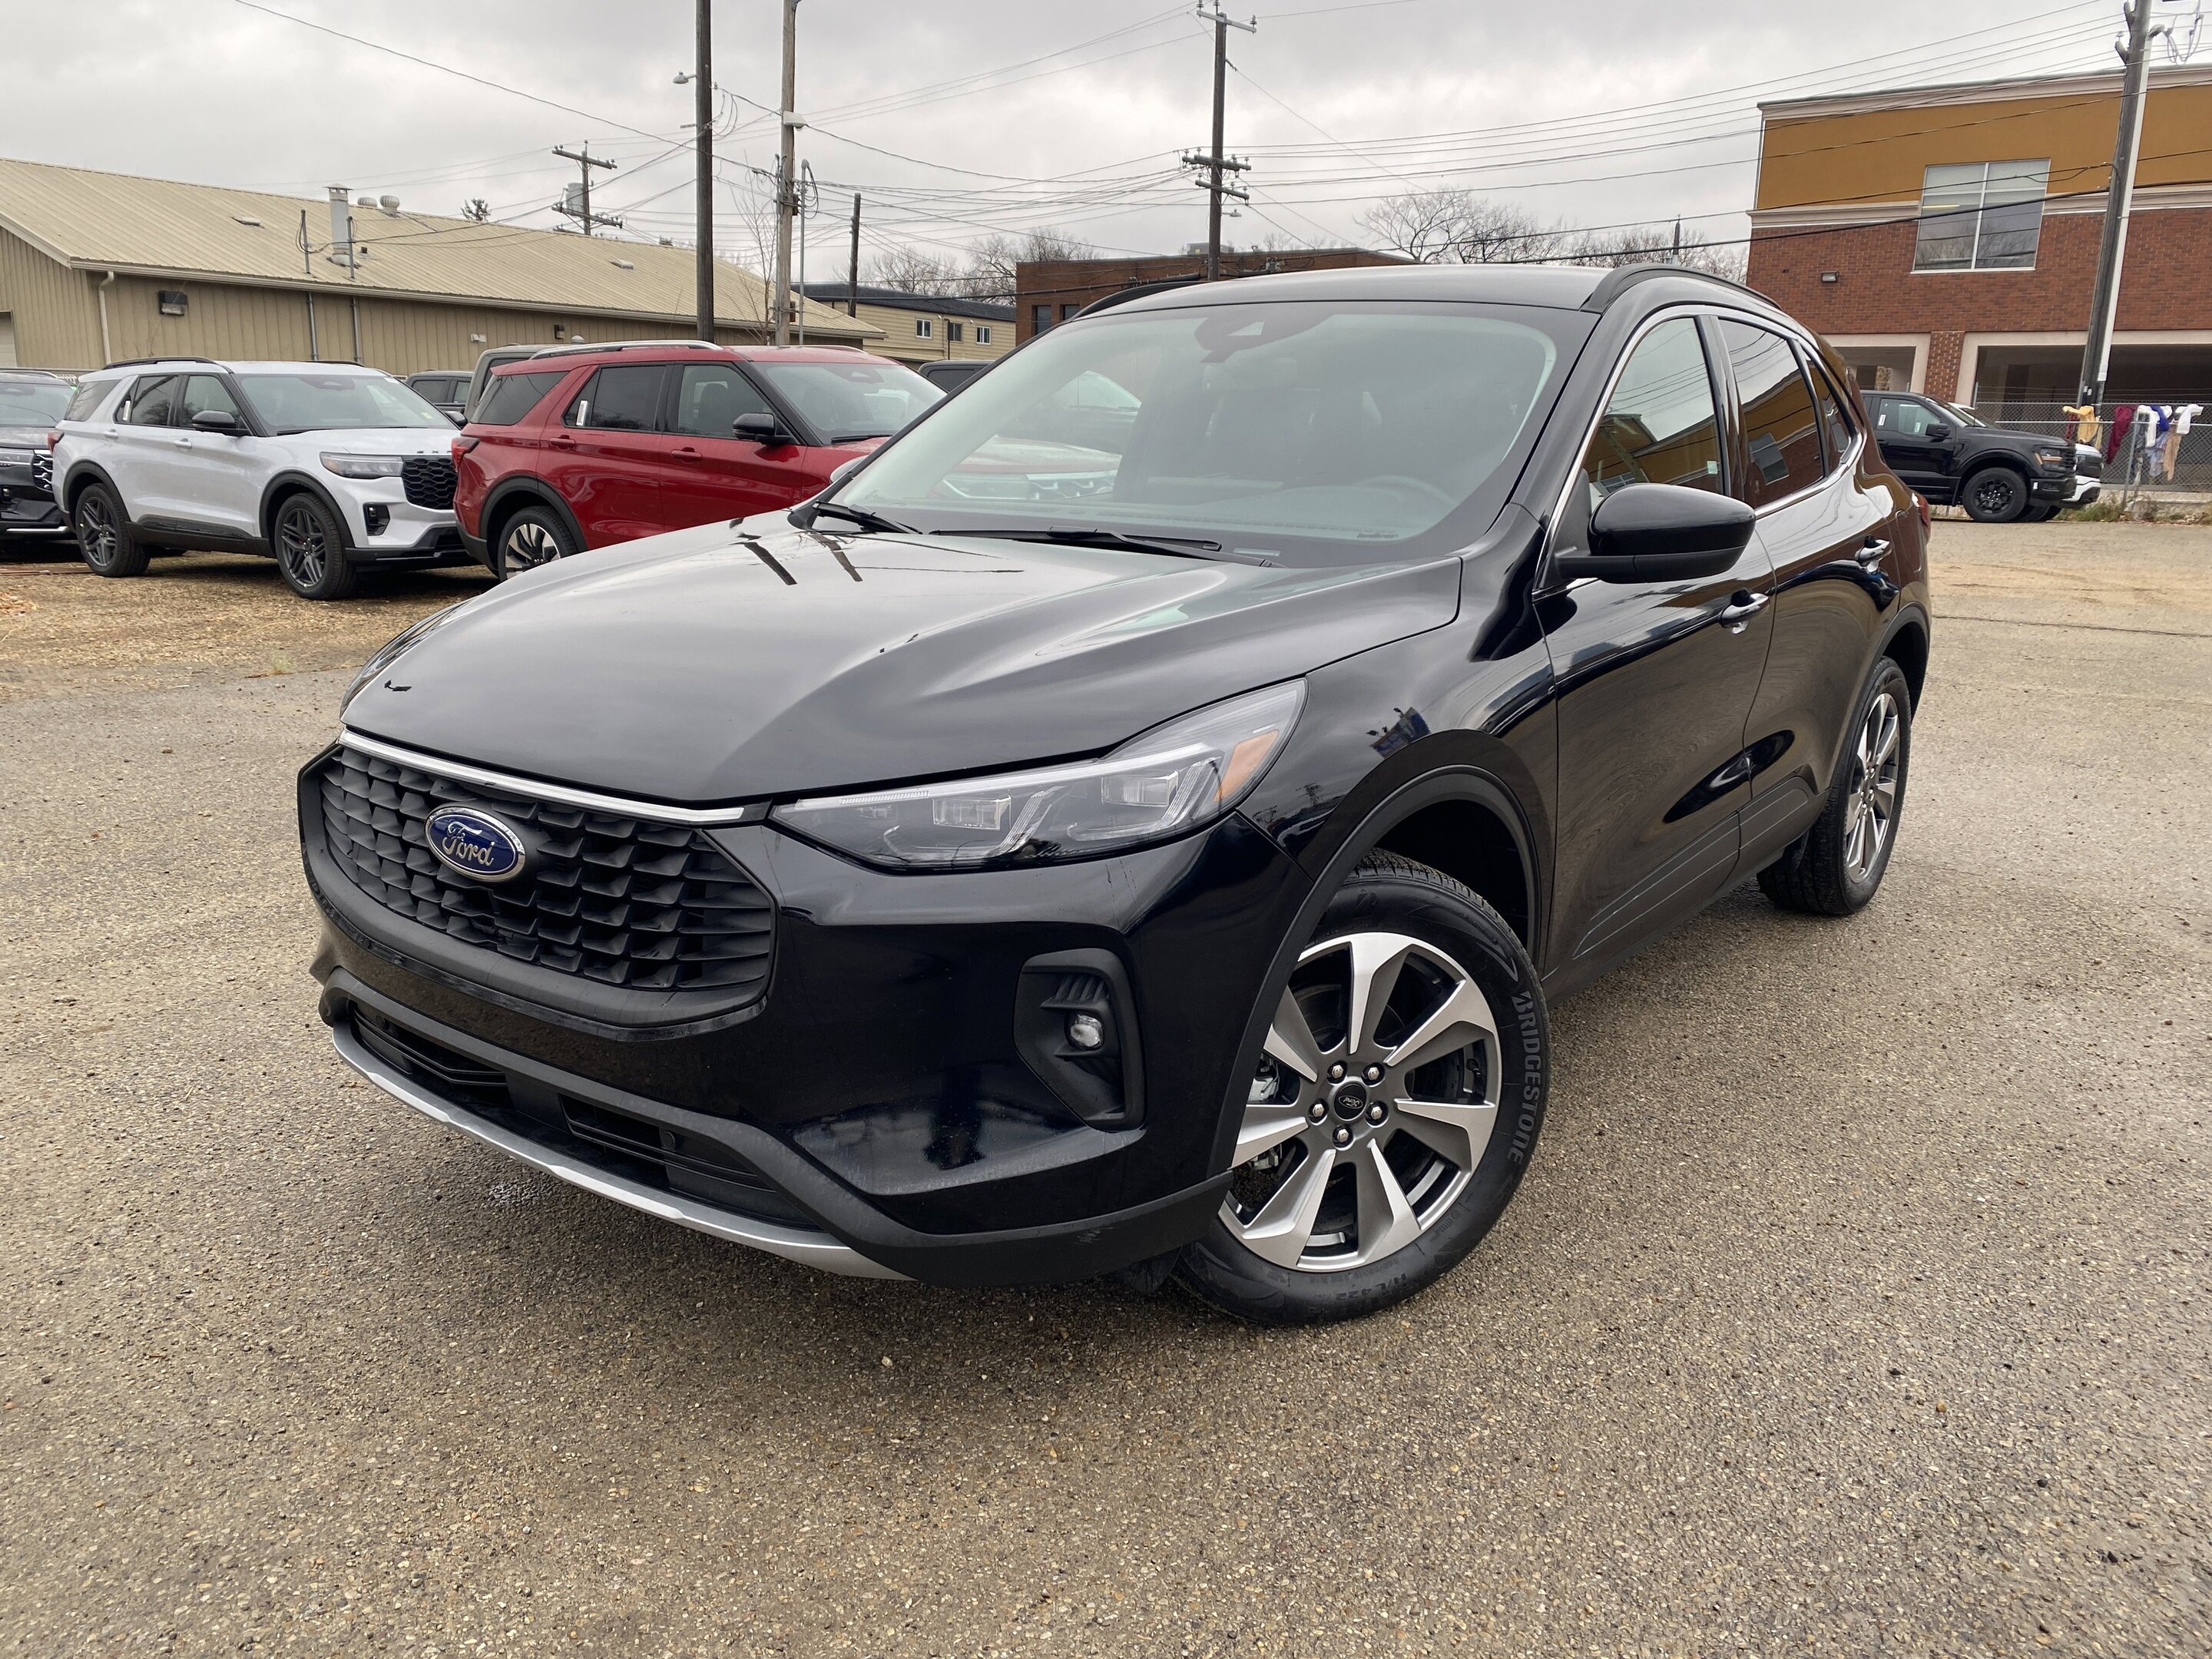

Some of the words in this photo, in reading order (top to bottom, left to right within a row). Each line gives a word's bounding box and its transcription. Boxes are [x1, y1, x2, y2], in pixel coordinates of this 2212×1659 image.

[442, 821, 495, 866] Ford
[1508, 991, 1541, 1164] BRIDGESTONE
[1343, 1098, 1360, 1107] Ford
